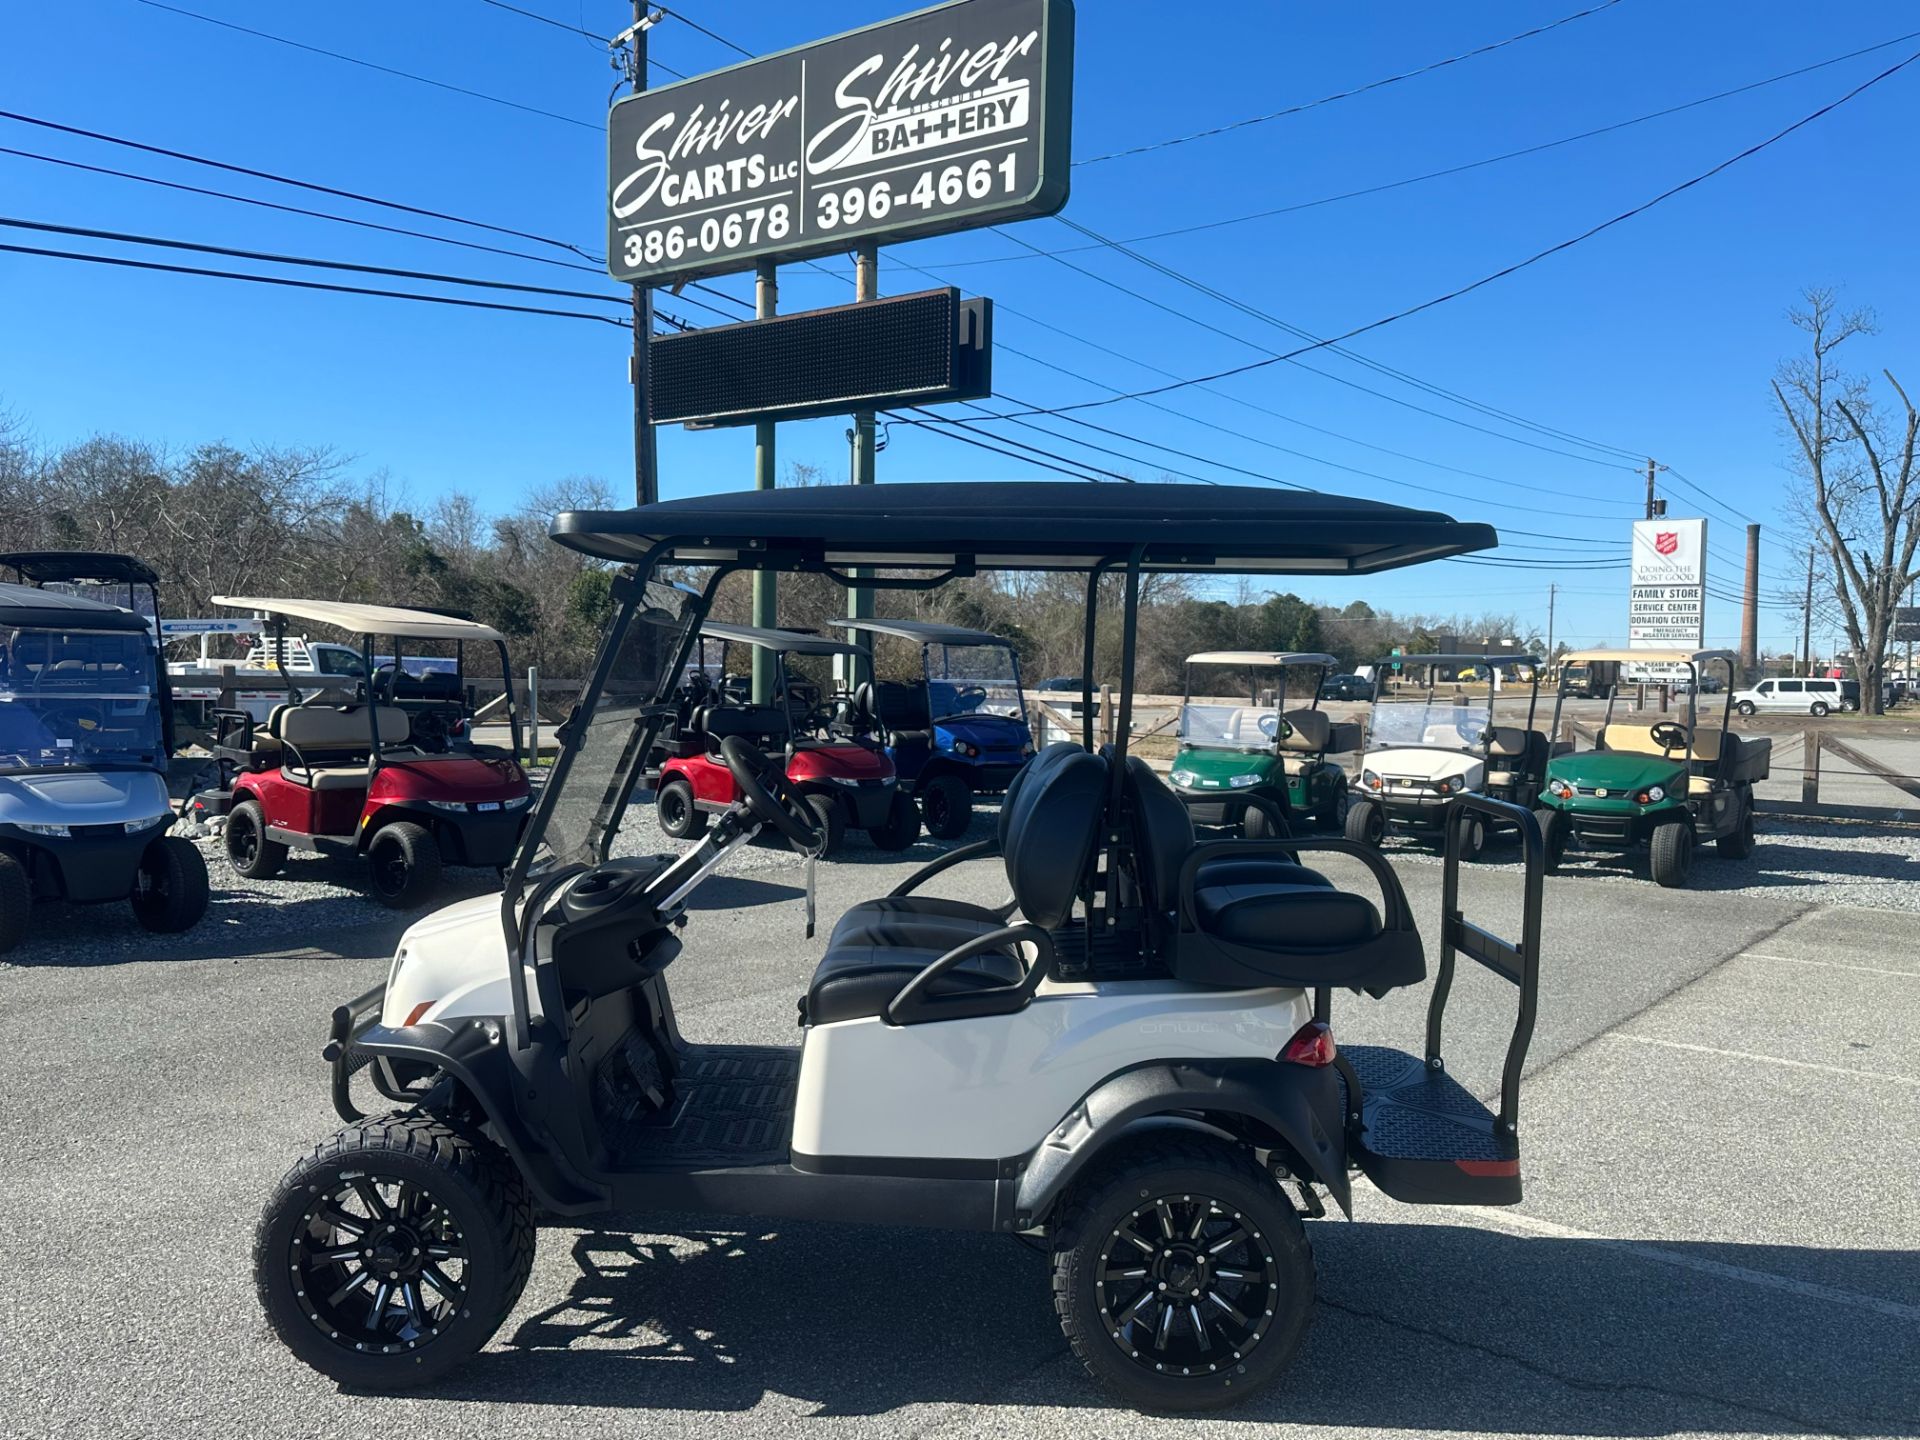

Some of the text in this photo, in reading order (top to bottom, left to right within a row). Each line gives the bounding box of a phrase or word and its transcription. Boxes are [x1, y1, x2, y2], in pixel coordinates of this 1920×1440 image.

[805, 30, 1038, 176] Shiver
[612, 95, 798, 219] Shiver
[660, 153, 798, 208] CARTS LLC
[816, 152, 1017, 230] 396-4661
[623, 203, 790, 268] 386-0678
[1637, 573, 1695, 582] MOST GOOD
[1640, 565, 1692, 574] DOING THE
[1633, 588, 1699, 599] FAMILY STORE
[1633, 603, 1697, 612] SERVICE CENTER
[1631, 616, 1700, 625] DONATION CENTER
